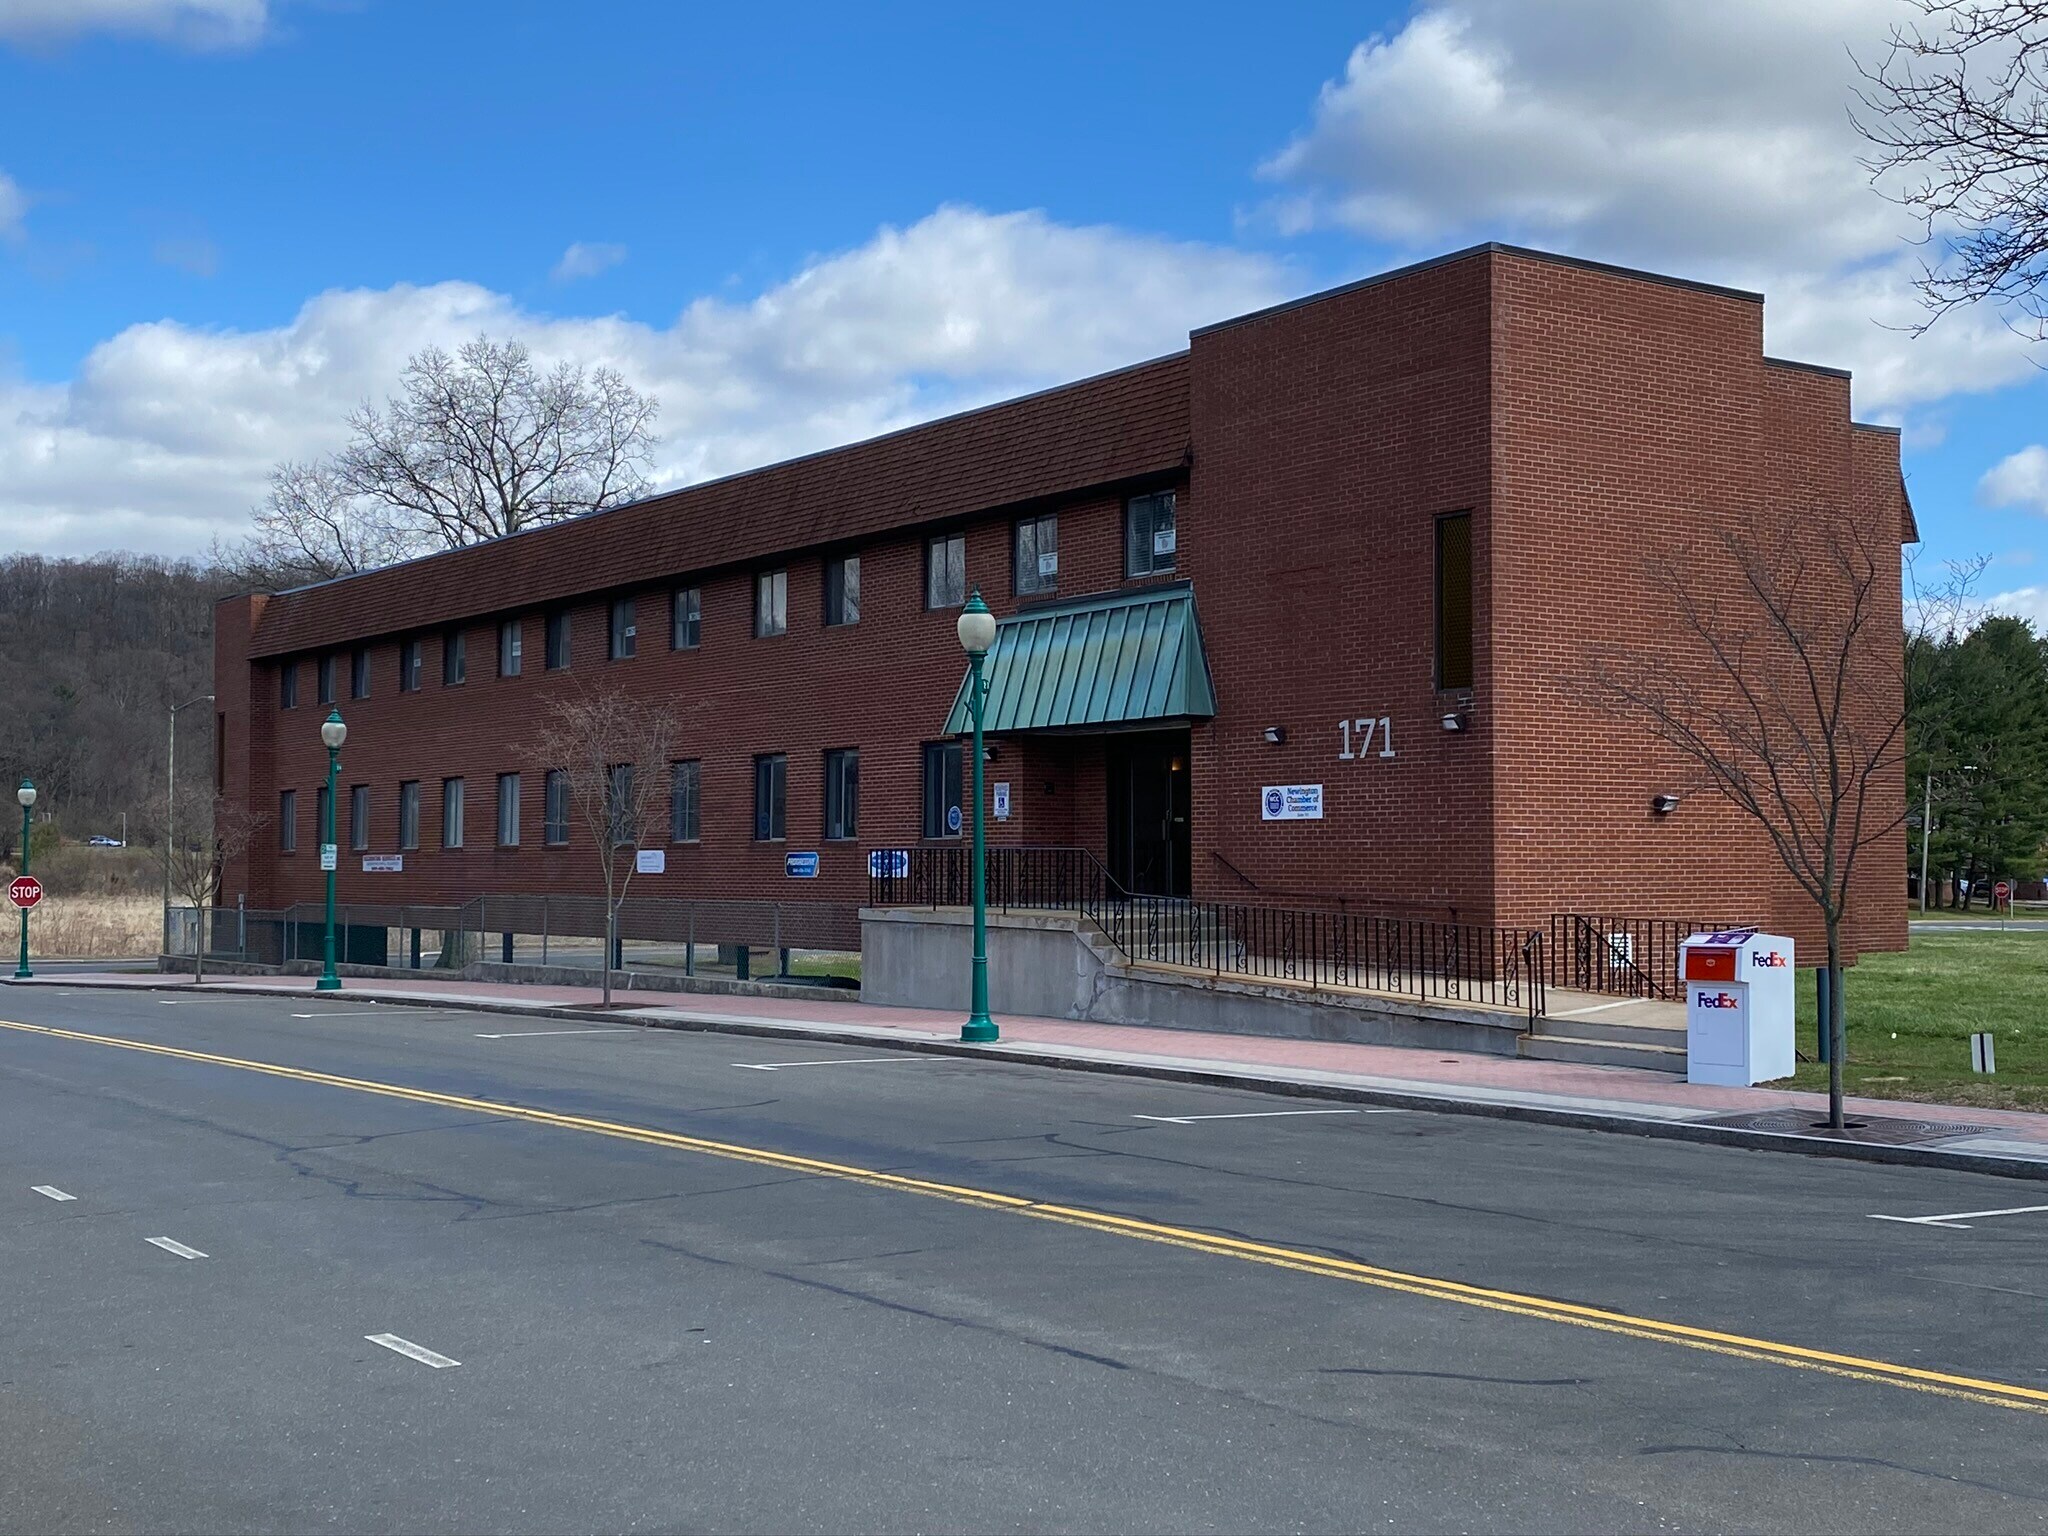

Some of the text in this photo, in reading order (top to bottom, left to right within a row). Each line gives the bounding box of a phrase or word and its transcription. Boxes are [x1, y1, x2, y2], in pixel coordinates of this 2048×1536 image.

[1339, 717, 1395, 759] 171
[1287, 787, 1318, 796] Newington
[11, 886, 40, 898] STOP
[1752, 951, 1786, 967] FedEx
[1698, 992, 1738, 1008] FedEx
